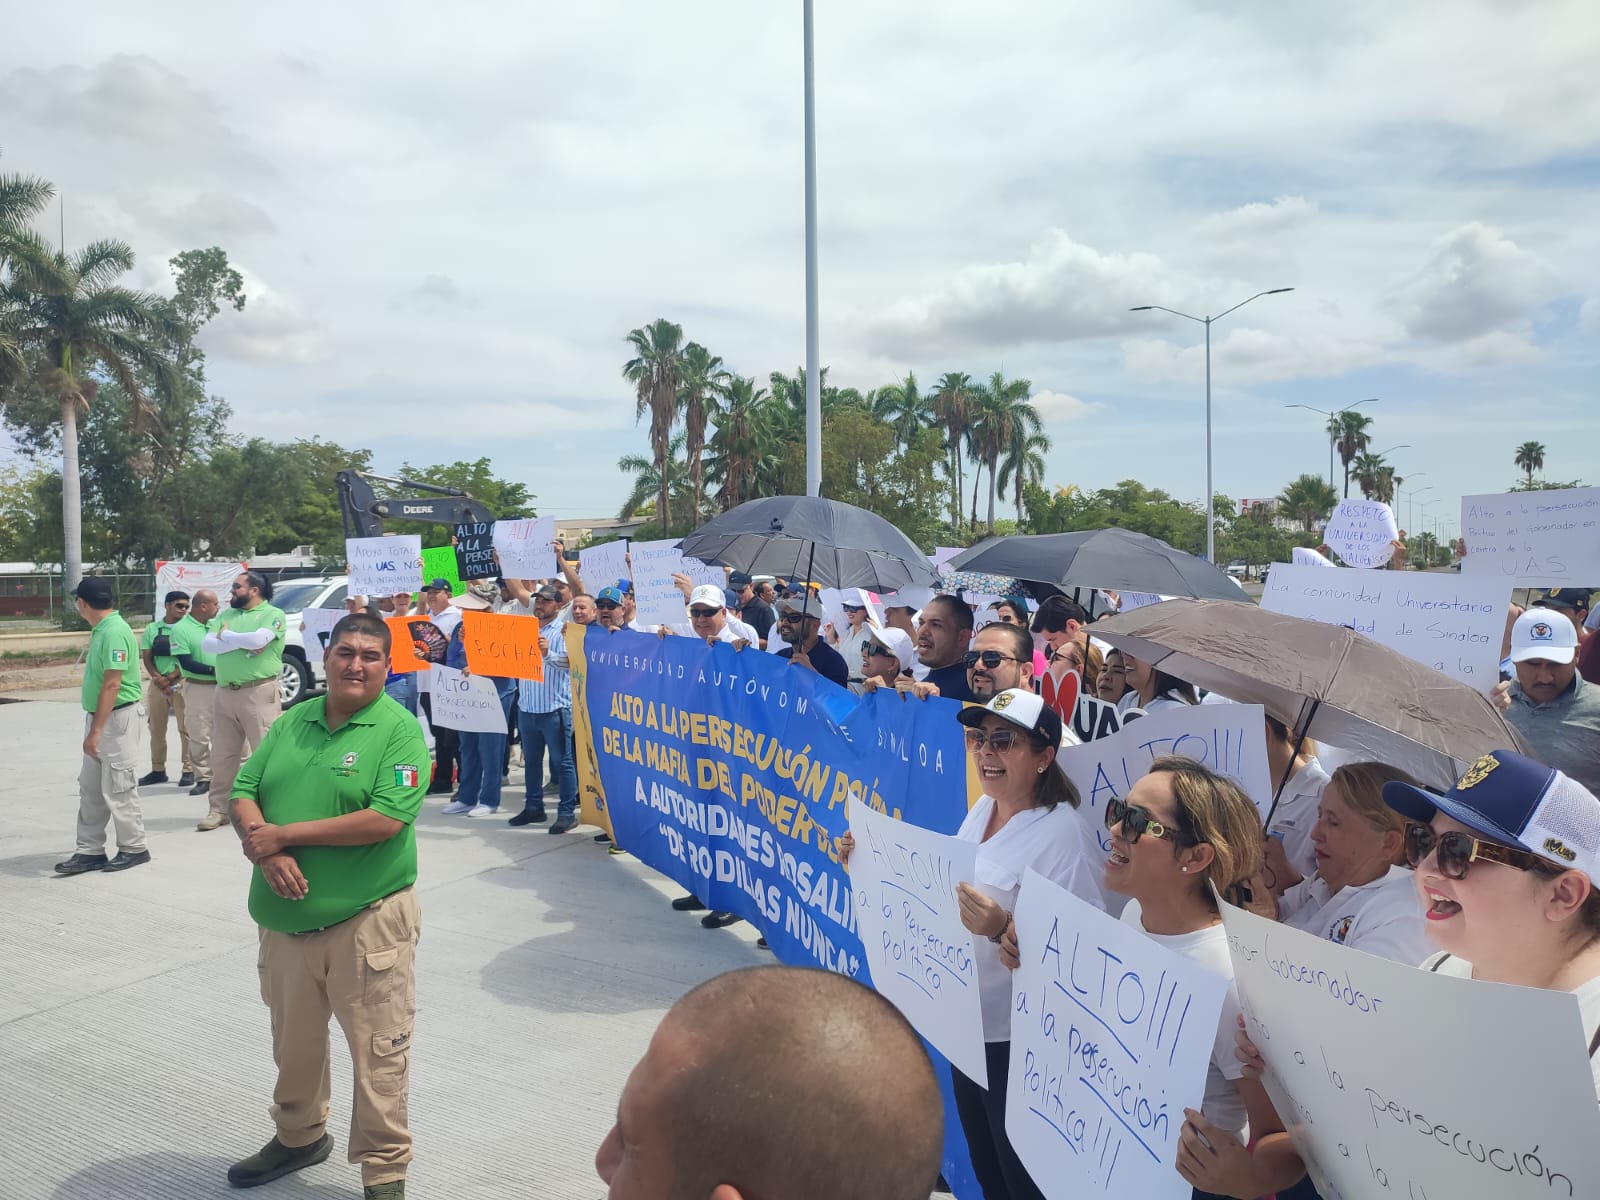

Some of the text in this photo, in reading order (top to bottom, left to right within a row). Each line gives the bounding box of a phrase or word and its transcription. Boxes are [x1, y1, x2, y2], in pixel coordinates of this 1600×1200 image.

[403, 505, 434, 514] DEERE
[457, 523, 487, 538] ALTO
[457, 539, 480, 553] A LA
[376, 561, 396, 572] UAS
[1501, 556, 1567, 576] UAS
[1272, 571, 1289, 592] La
[1303, 584, 1381, 605] comunidad
[1395, 622, 1414, 636] de
[1426, 621, 1490, 643] Sinaloa
[1433, 655, 1474, 674] a la
[437, 670, 470, 693] ALTO
[591, 649, 684, 679] UNIVERSIDAD
[698, 668, 819, 719] AUTÓNOM
[610, 691, 643, 727] ALTO
[646, 701, 659, 731] A
[661, 703, 679, 739] LA
[603, 726, 622, 757] DE
[624, 732, 643, 766] LA
[645, 739, 692, 788] MAFIA
[696, 757, 737, 802] DEL
[741, 773, 814, 845] PODER
[635, 776, 648, 806] A
[650, 781, 776, 869] AUTORIDADES
[858, 890, 870, 908] a
[881, 890, 893, 919] la
[1228, 932, 1383, 1013] eñor Gobernador
[1016, 991, 1029, 1014] a
[1041, 984, 1057, 1042] la
[1293, 1051, 1306, 1065] a
[1319, 1045, 1346, 1092] la
[1338, 1143, 1350, 1159] a
[1365, 1143, 1391, 1192] la
